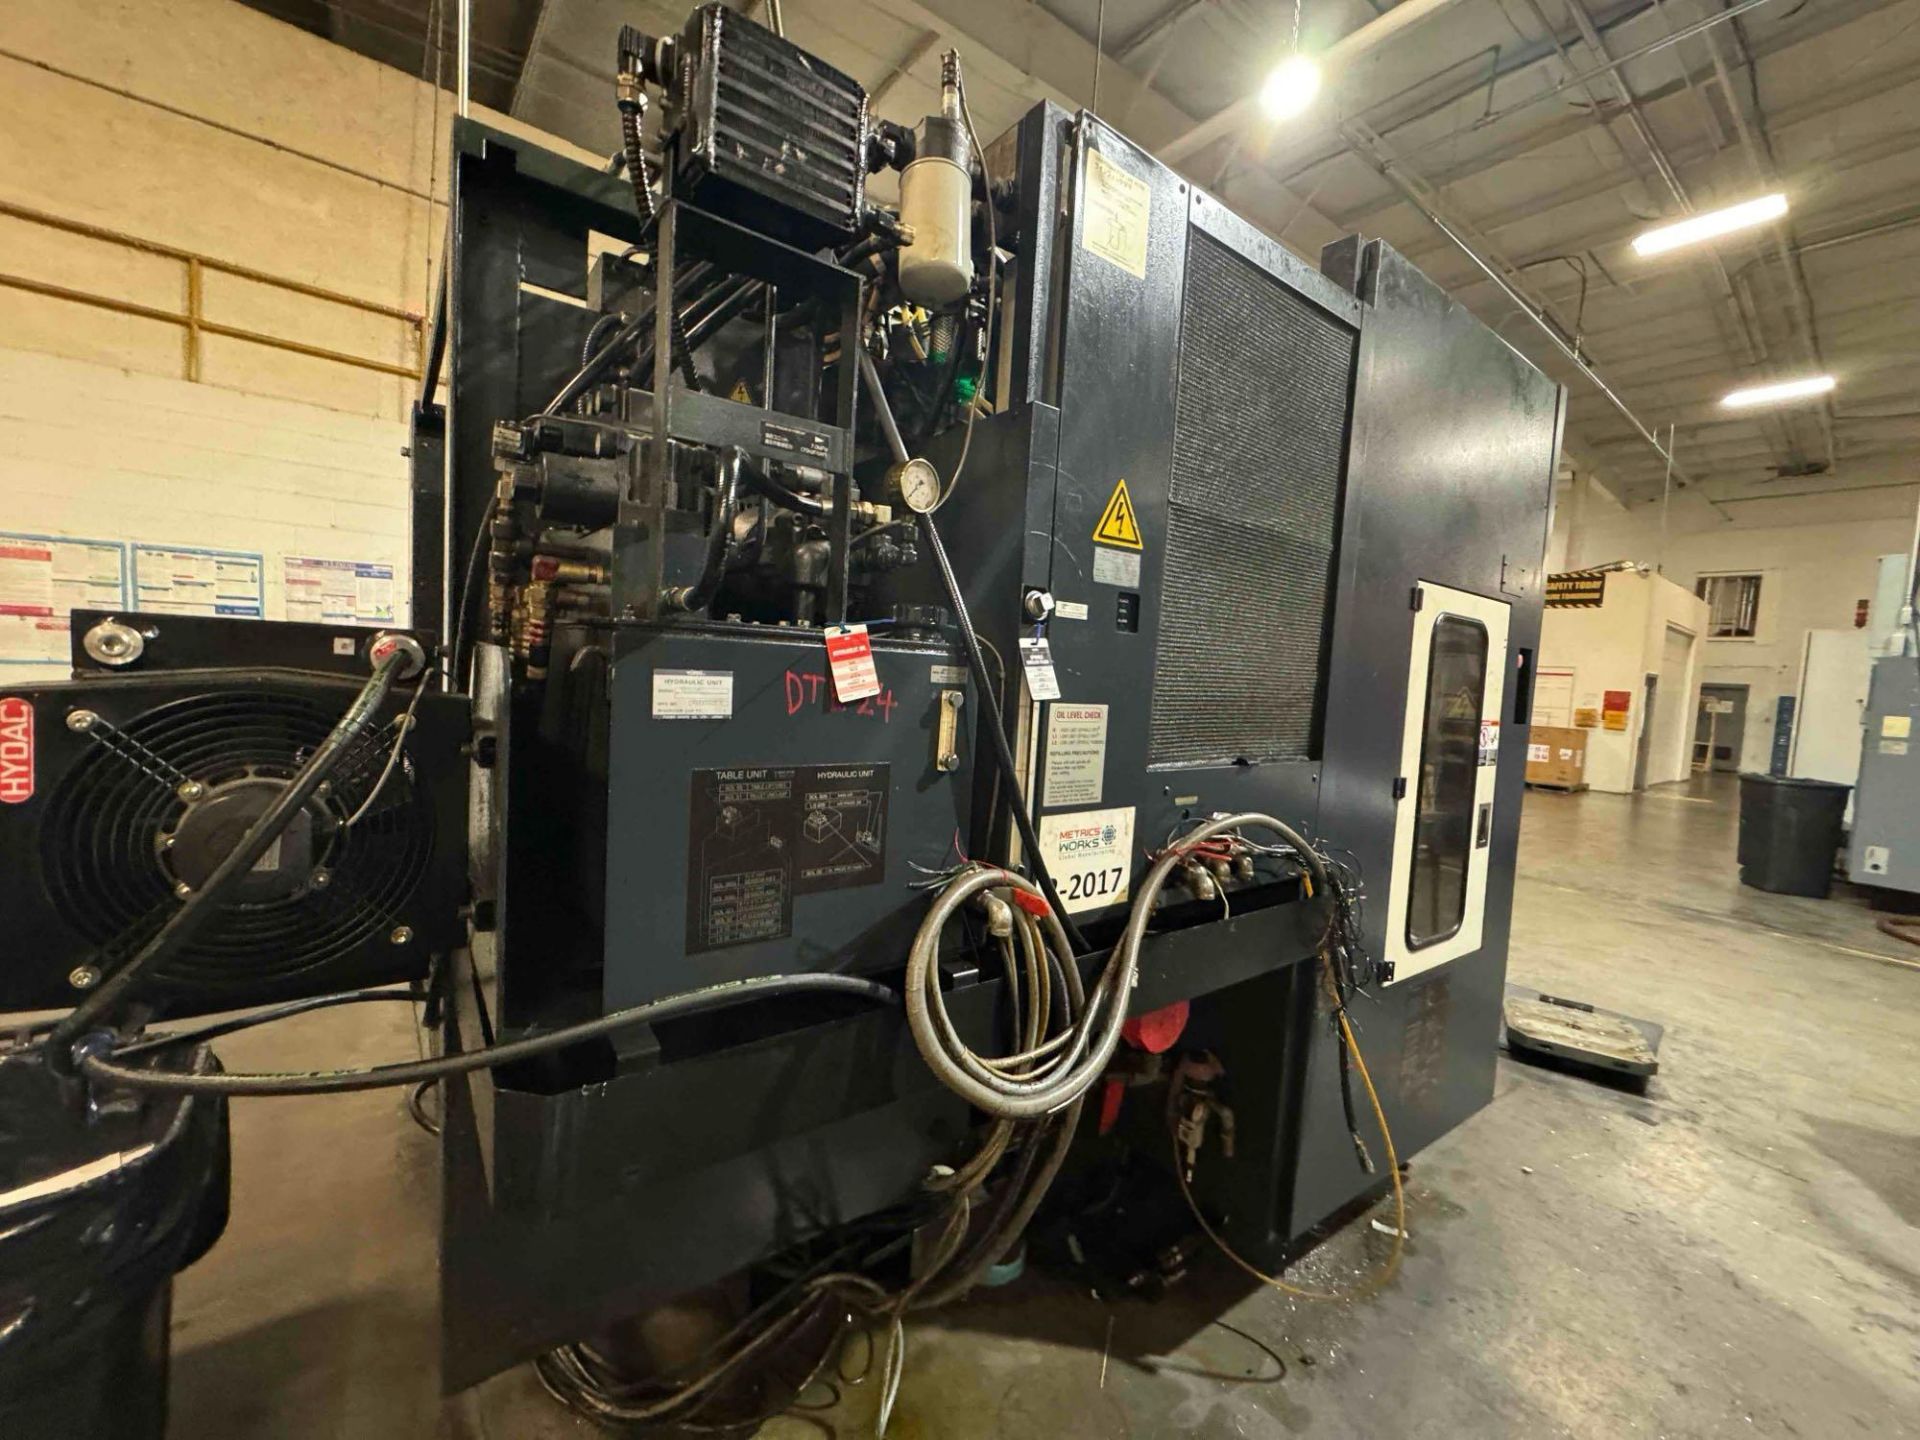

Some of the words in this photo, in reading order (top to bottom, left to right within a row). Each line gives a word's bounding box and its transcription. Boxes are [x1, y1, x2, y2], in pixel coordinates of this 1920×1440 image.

[1067, 711, 1083, 719] LEVEL
[1084, 711, 1101, 719] CHECK
[0, 704, 29, 796] HYDAC
[716, 771, 744, 780] TABLE
[746, 769, 768, 779] UNIT
[817, 771, 858, 780] HYDRAULIC
[858, 769, 875, 777] UNIT
[1060, 827, 1101, 840] METRICS
[1059, 838, 1100, 852] WORKS
